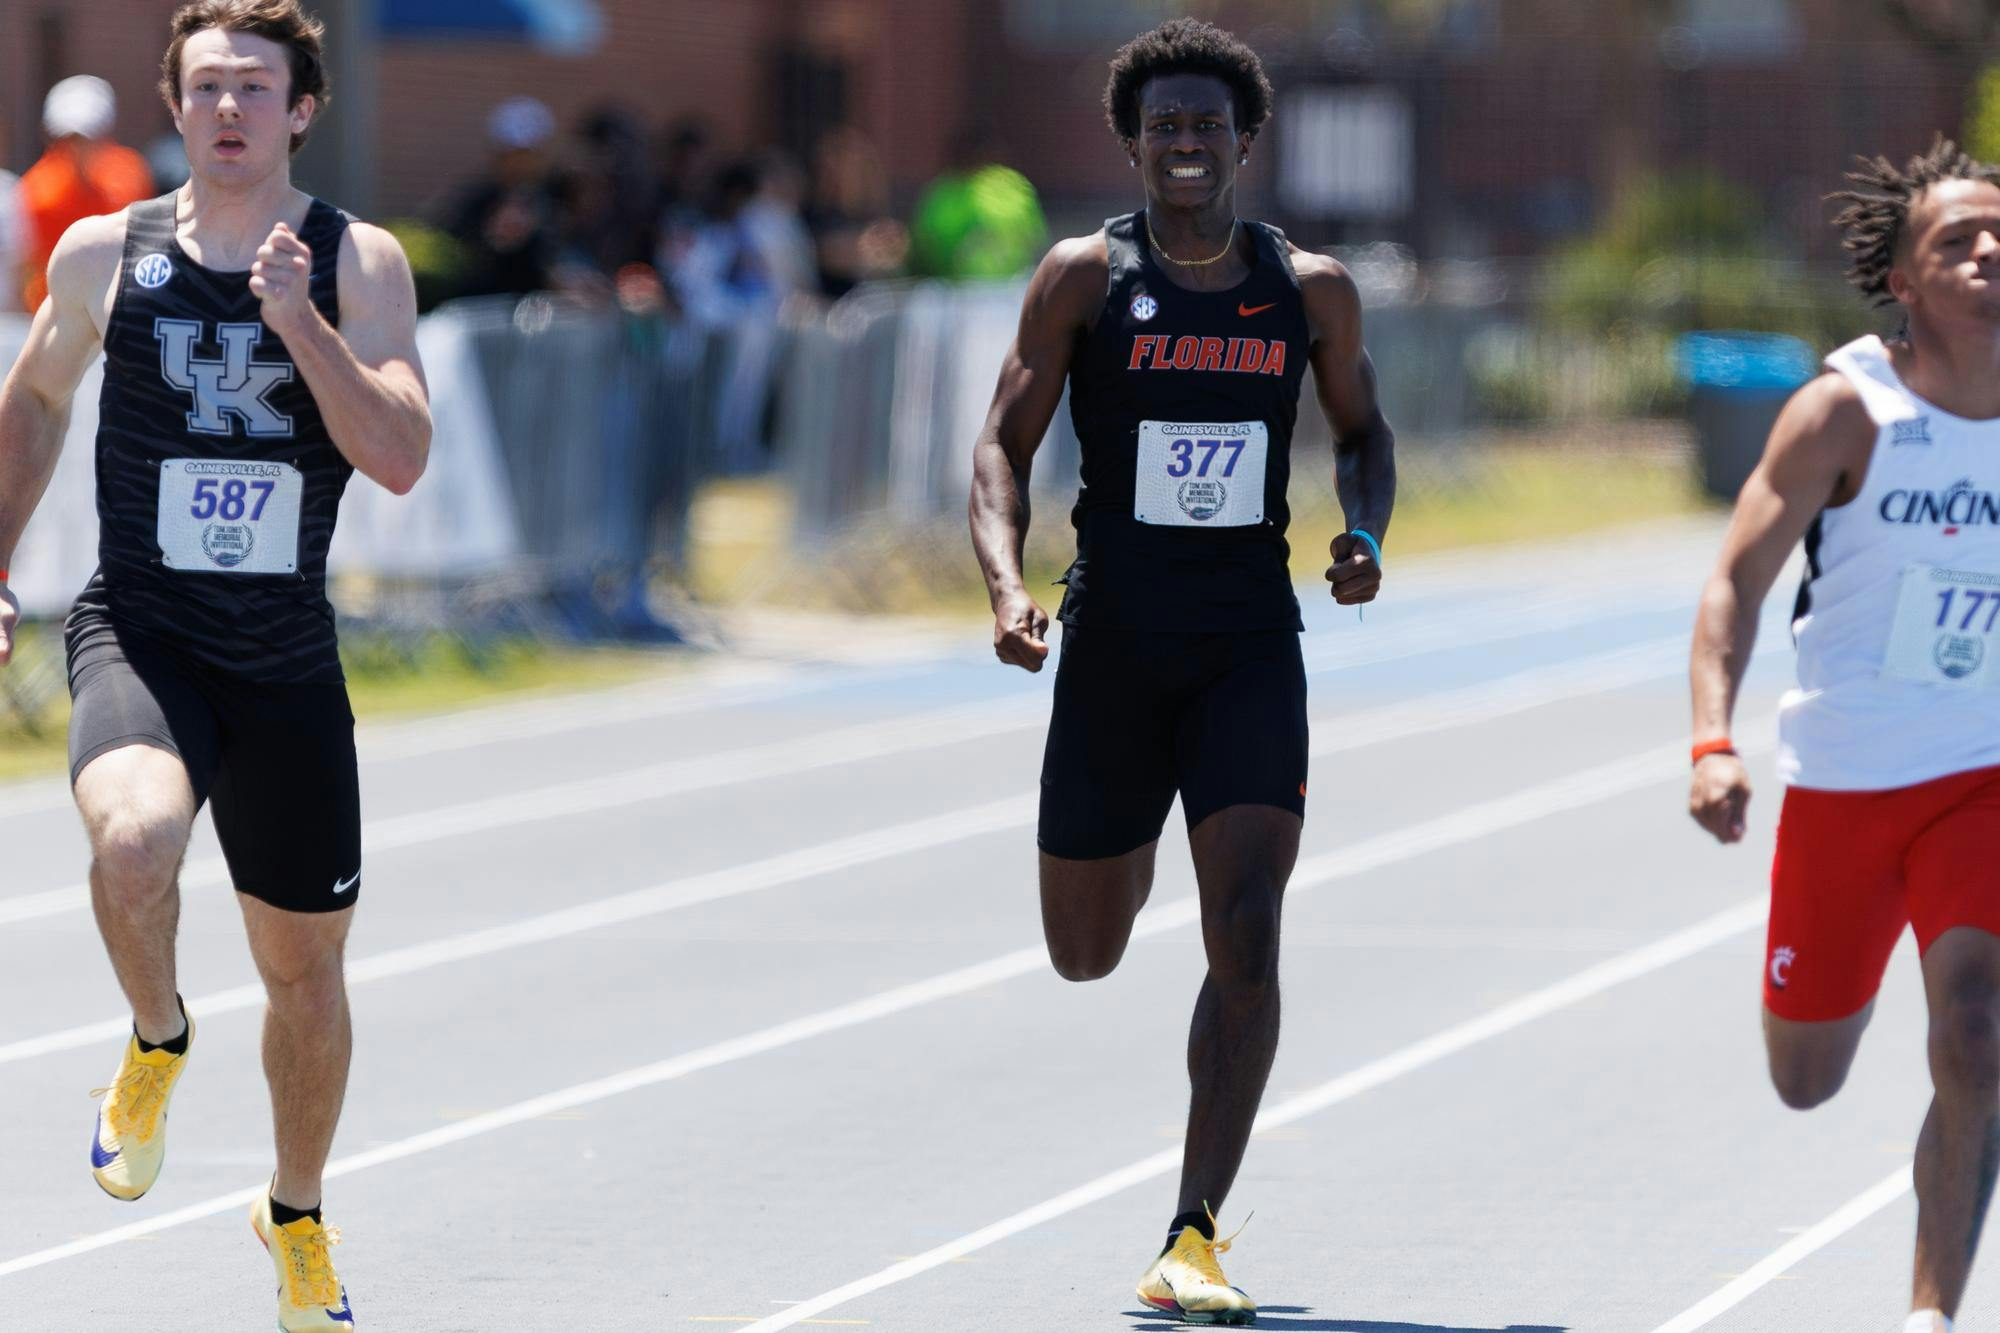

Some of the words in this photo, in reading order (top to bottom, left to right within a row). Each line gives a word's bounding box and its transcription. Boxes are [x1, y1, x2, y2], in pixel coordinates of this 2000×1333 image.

[138, 256, 169, 285] SEC
[1132, 296, 1157, 320] SEC
[1127, 335, 1287, 376] FLORIDA
[153, 317, 294, 437] UK
[1162, 424, 1237, 437] GAINESVILLE,
[1238, 424, 1251, 436] FL
[185, 462, 264, 477] GAINESVILLE,
[265, 464, 281, 476] FL
[1167, 439, 1246, 477] 377
[190, 479, 275, 521] 587
[214, 525, 226, 533] TOM
[226, 525, 243, 533] JONES
[210, 541, 243, 549] INVITATIONAL
[1936, 586, 2000, 633] 177
